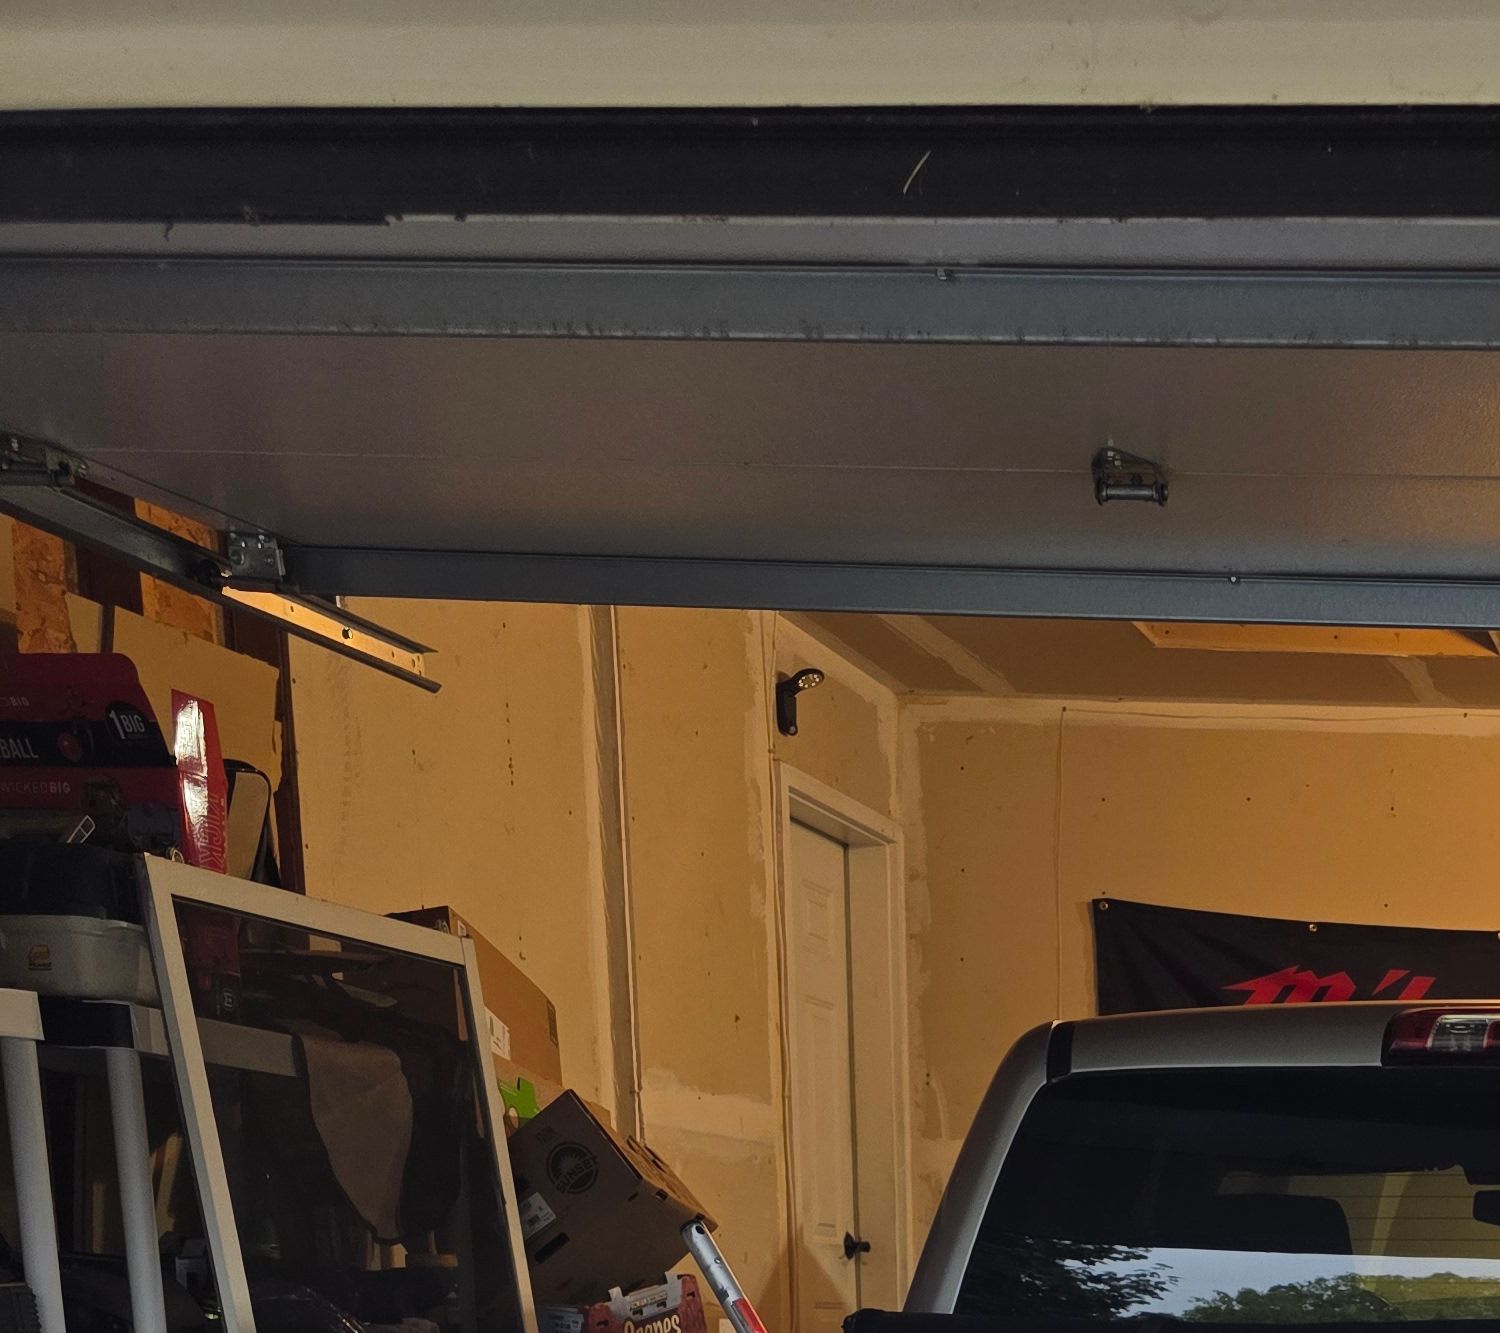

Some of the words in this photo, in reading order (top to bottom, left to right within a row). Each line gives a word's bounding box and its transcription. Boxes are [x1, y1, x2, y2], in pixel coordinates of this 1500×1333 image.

[109, 710, 125, 740] 1
[120, 715, 145, 733] BIG
[554, 1152, 600, 1195] SUNSET
